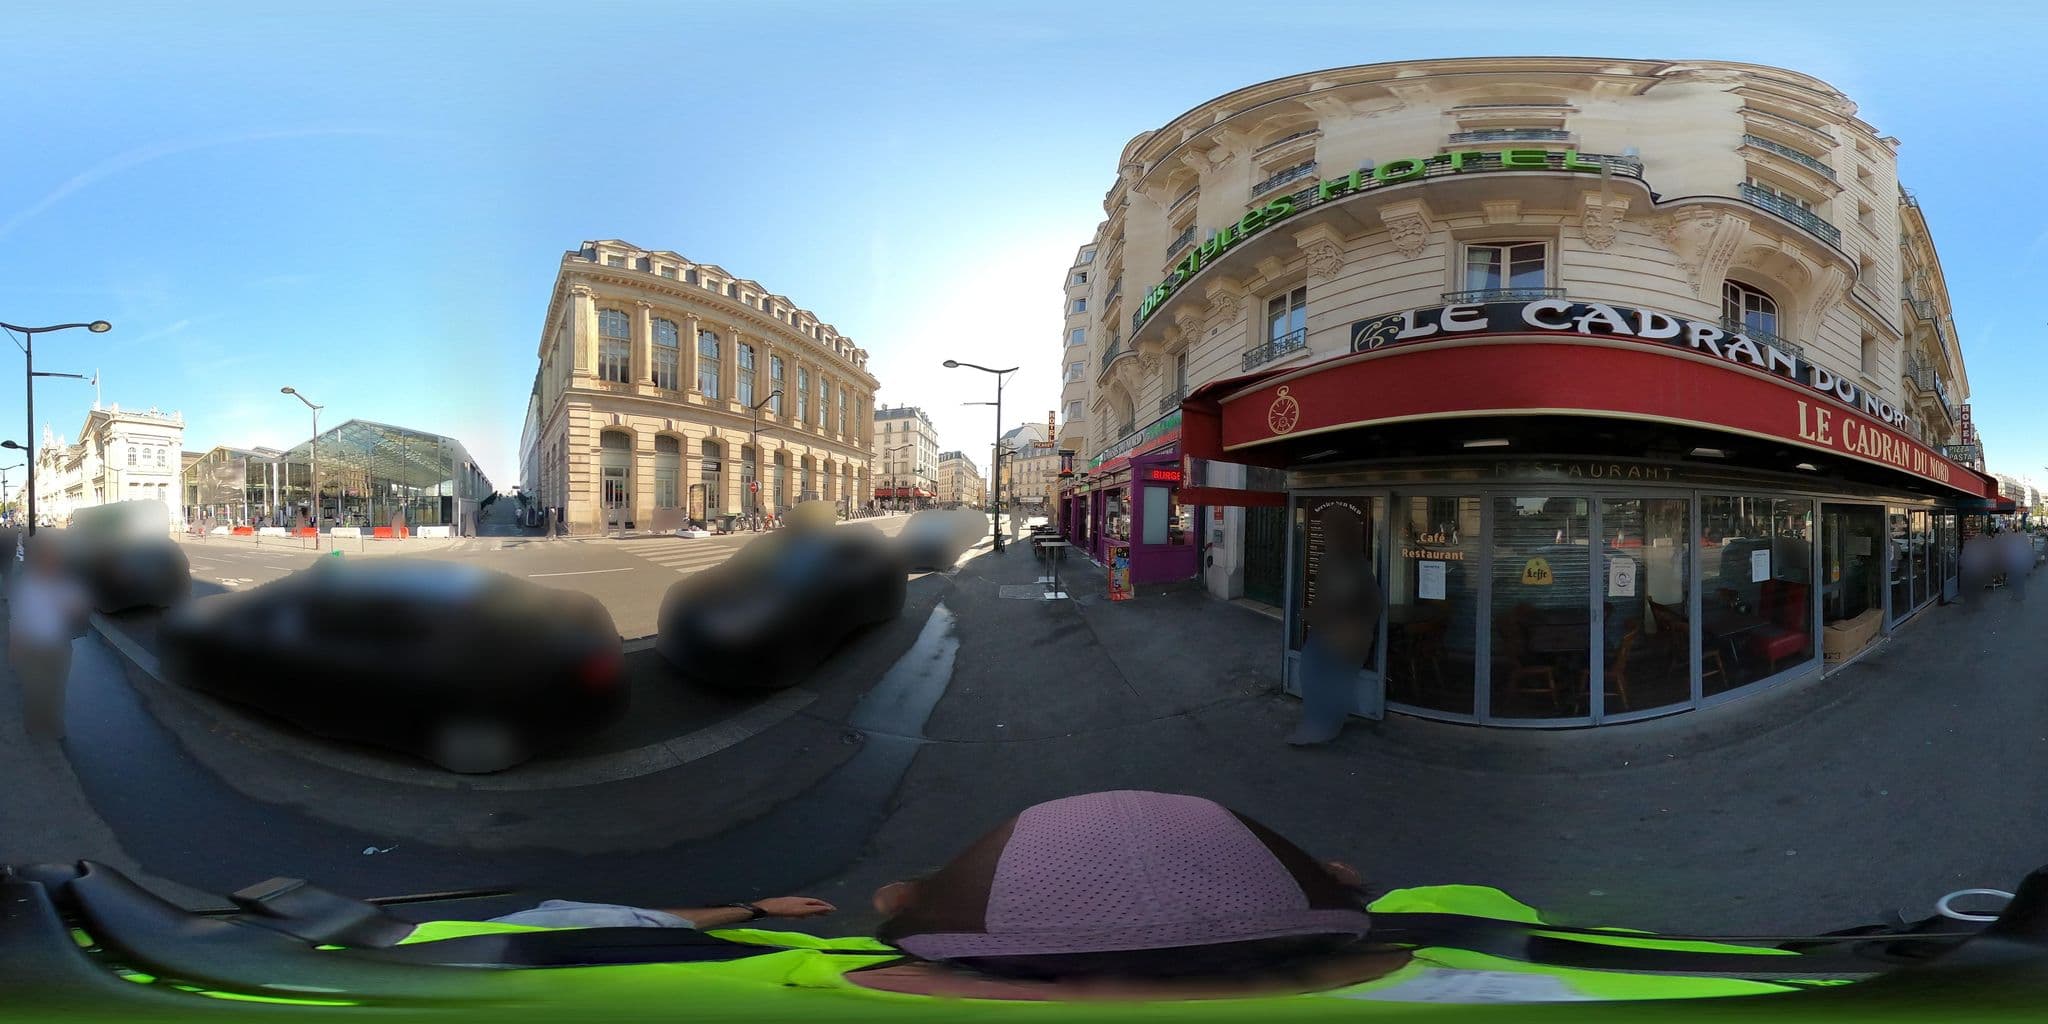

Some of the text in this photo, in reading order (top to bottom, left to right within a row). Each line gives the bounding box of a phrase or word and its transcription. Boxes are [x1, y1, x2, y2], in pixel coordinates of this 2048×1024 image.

[1139, 283, 1167, 321] ibis
[1319, 148, 1605, 200] HOTEL
[1395, 303, 1489, 340] LE
[1521, 299, 1796, 379] CADRAN
[1962, 405, 1970, 445] HOTEL
[1798, 400, 1949, 483] LE CADRAN DU NORD
[1949, 453, 1973, 462] PASTA
[1419, 532, 1446, 543] Café
[1401, 548, 1465, 561] Restaurant
[1526, 568, 1548, 581] Leffe
